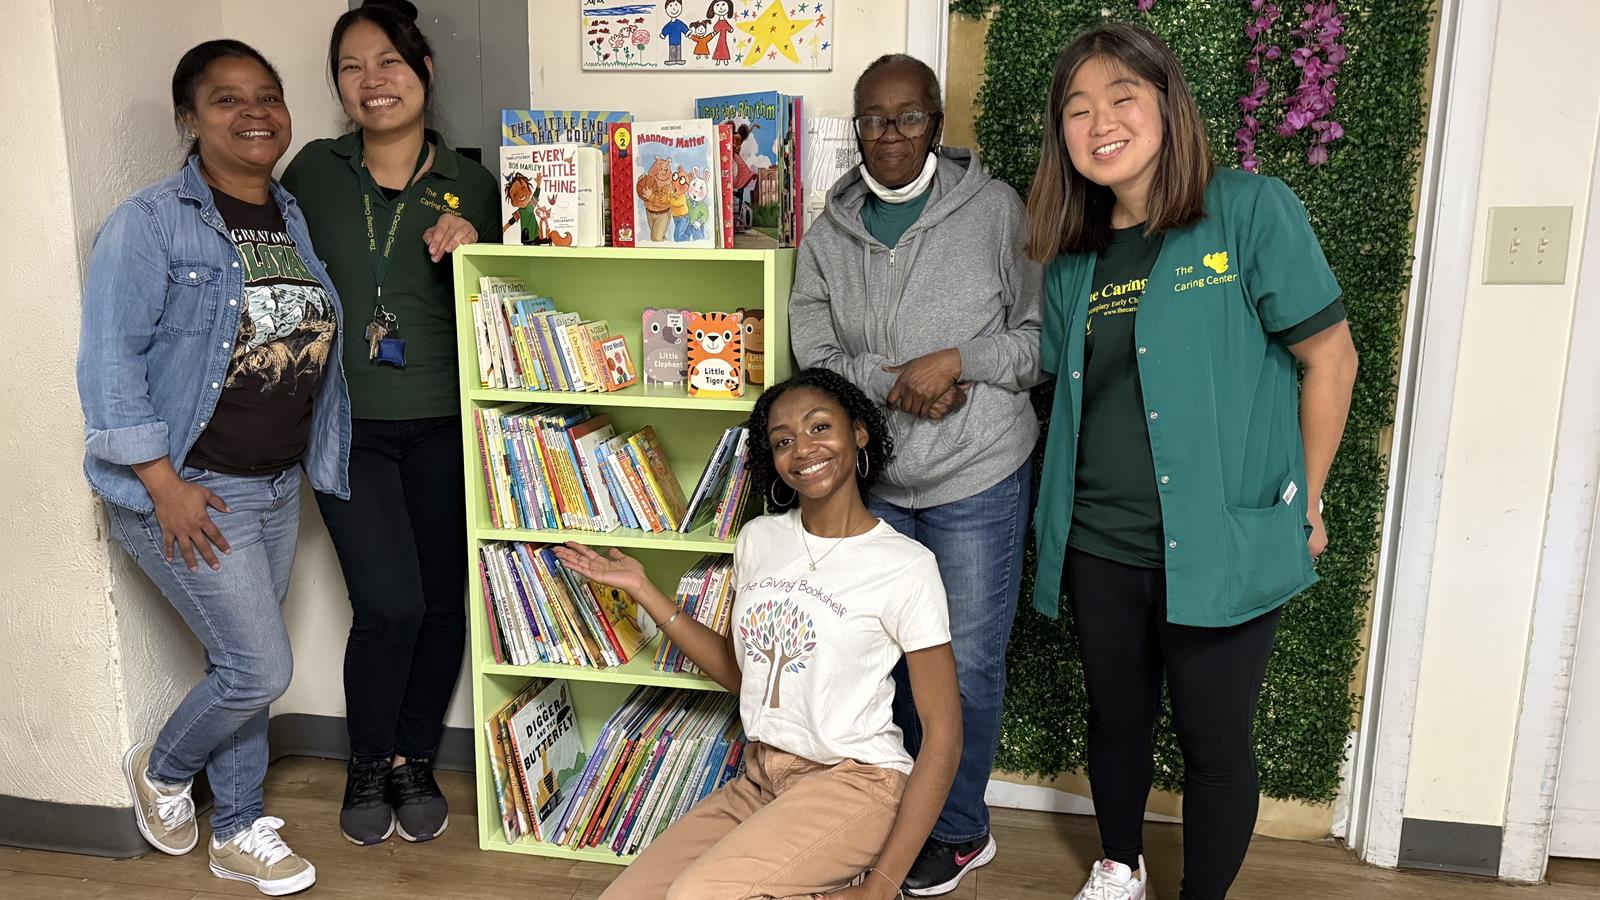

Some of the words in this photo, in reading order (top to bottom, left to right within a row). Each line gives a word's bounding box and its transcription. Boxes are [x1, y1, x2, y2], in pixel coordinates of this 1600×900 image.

[738, 99, 776, 122] Rhythm
[510, 121, 531, 137] THE
[537, 117, 576, 131] LITTLE
[581, 118, 609, 134] ENGI
[532, 130, 560, 145] THAT
[566, 130, 603, 145] COULD
[619, 138, 626, 147] 2
[636, 133, 674, 146] Manners
[675, 136, 705, 148] Matter
[532, 148, 565, 163] EVERY
[519, 163, 541, 171] MARLEY
[425, 187, 438, 197] The
[420, 197, 441, 211] Caring
[441, 204, 462, 217] Center
[231, 228, 270, 242] GREAT
[1174, 266, 1193, 277] The
[1174, 277, 1205, 292] Caring
[1206, 273, 1238, 285] Center
[1103, 307, 1137, 316] www.thecari
[603, 343, 613, 352] First
[659, 351, 679, 359] Little
[654, 361, 684, 369] Elephant
[704, 367, 725, 376] Little
[706, 377, 724, 386] Tiger
[740, 580, 758, 595] The
[760, 577, 797, 593] Giving
[798, 579, 847, 618] Bookshelf
[536, 701, 545, 713] THE
[526, 699, 561, 738] DIGGER
[537, 728, 547, 740] AND
[546, 718, 556, 731] THE
[523, 713, 573, 771] BUTTERFLY
